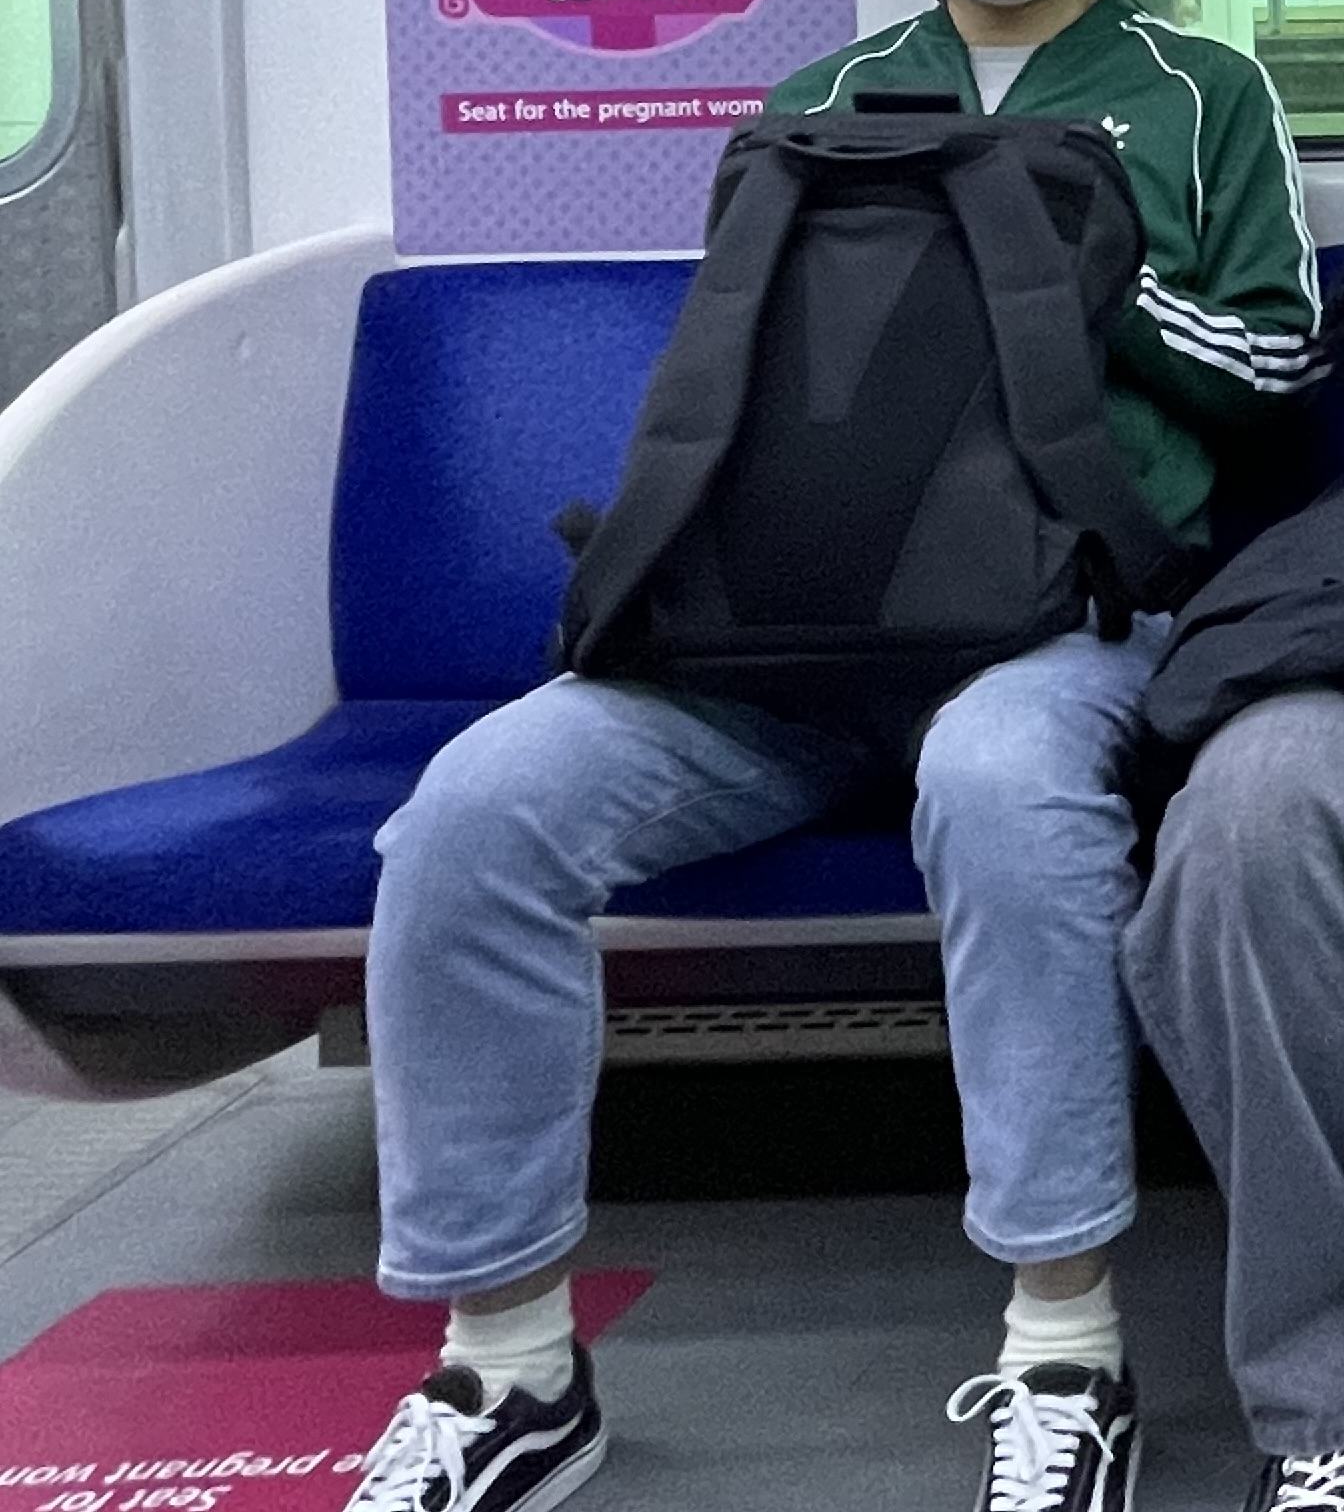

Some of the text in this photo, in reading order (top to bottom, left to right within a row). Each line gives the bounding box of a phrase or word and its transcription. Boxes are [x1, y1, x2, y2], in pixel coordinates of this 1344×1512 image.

[458, 98, 765, 126] Seat for the pregnant wom
[0, 1462, 97, 1486] wom
[103, 1448, 331, 1485] pregnant
[119, 1483, 232, 1512] Seat
